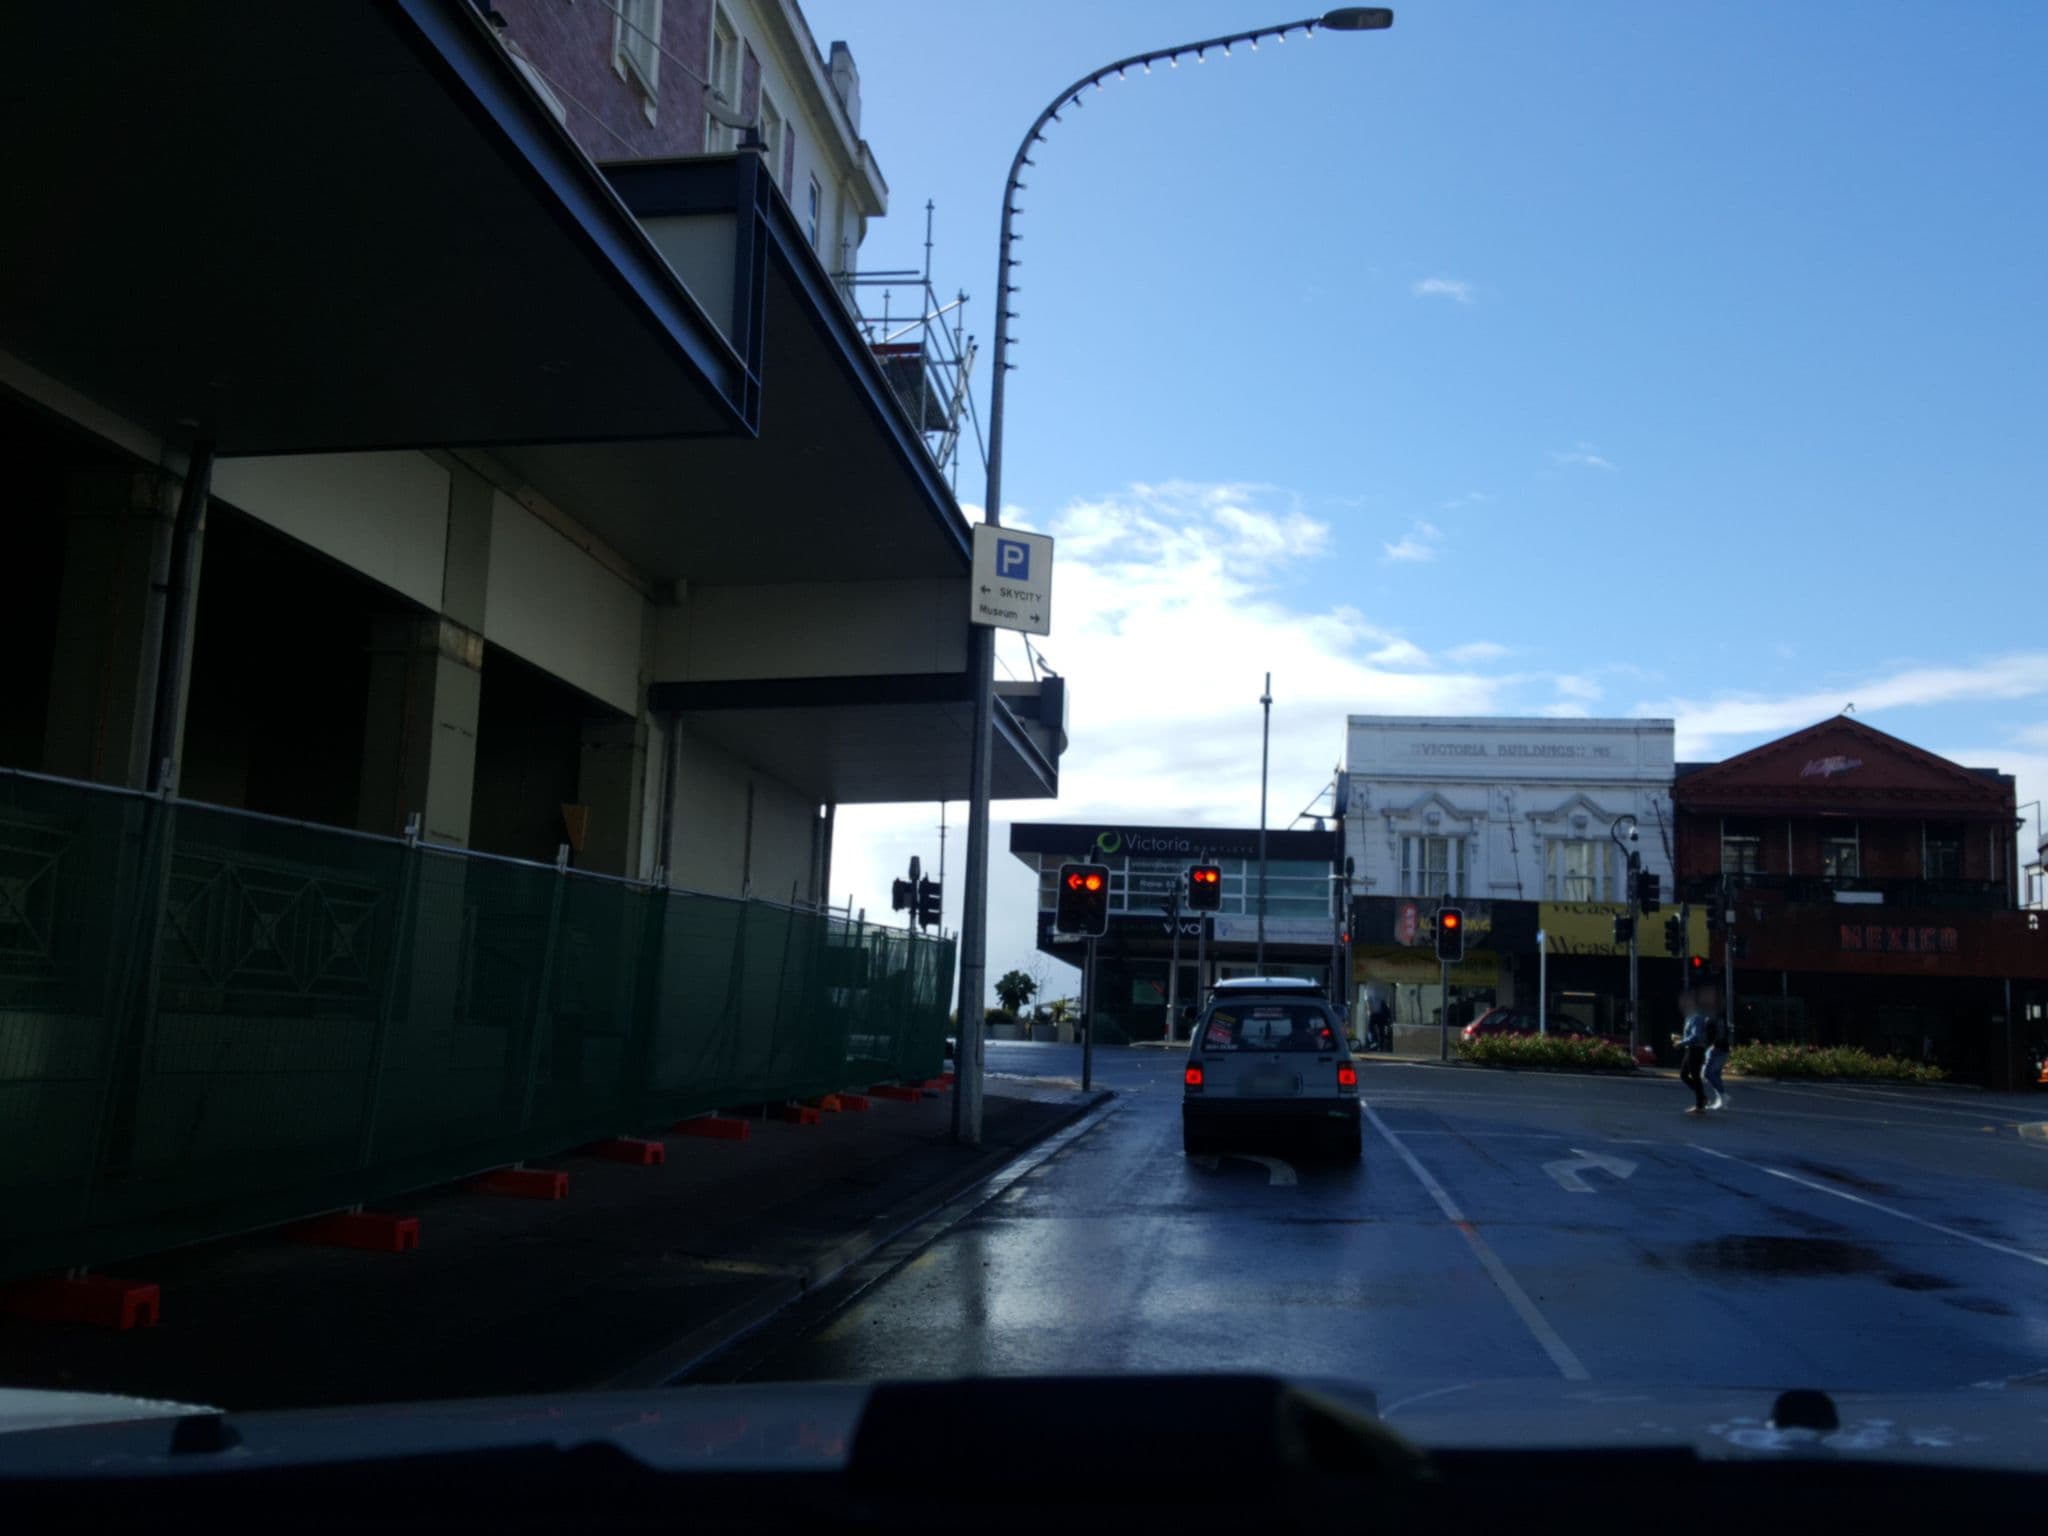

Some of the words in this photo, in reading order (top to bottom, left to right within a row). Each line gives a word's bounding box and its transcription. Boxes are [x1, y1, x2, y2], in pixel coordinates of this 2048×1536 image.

[1002, 544, 1024, 574] P
[1000, 586, 1042, 603] SKYCITY
[979, 604, 1018, 620] Museum
[1422, 743, 1489, 756] VICTORIA
[1497, 743, 1576, 757] BUILDINGS
[1125, 833, 1190, 852] Victoria
[1163, 920, 1201, 935] VVO
[1840, 925, 1958, 953] MEXICO
